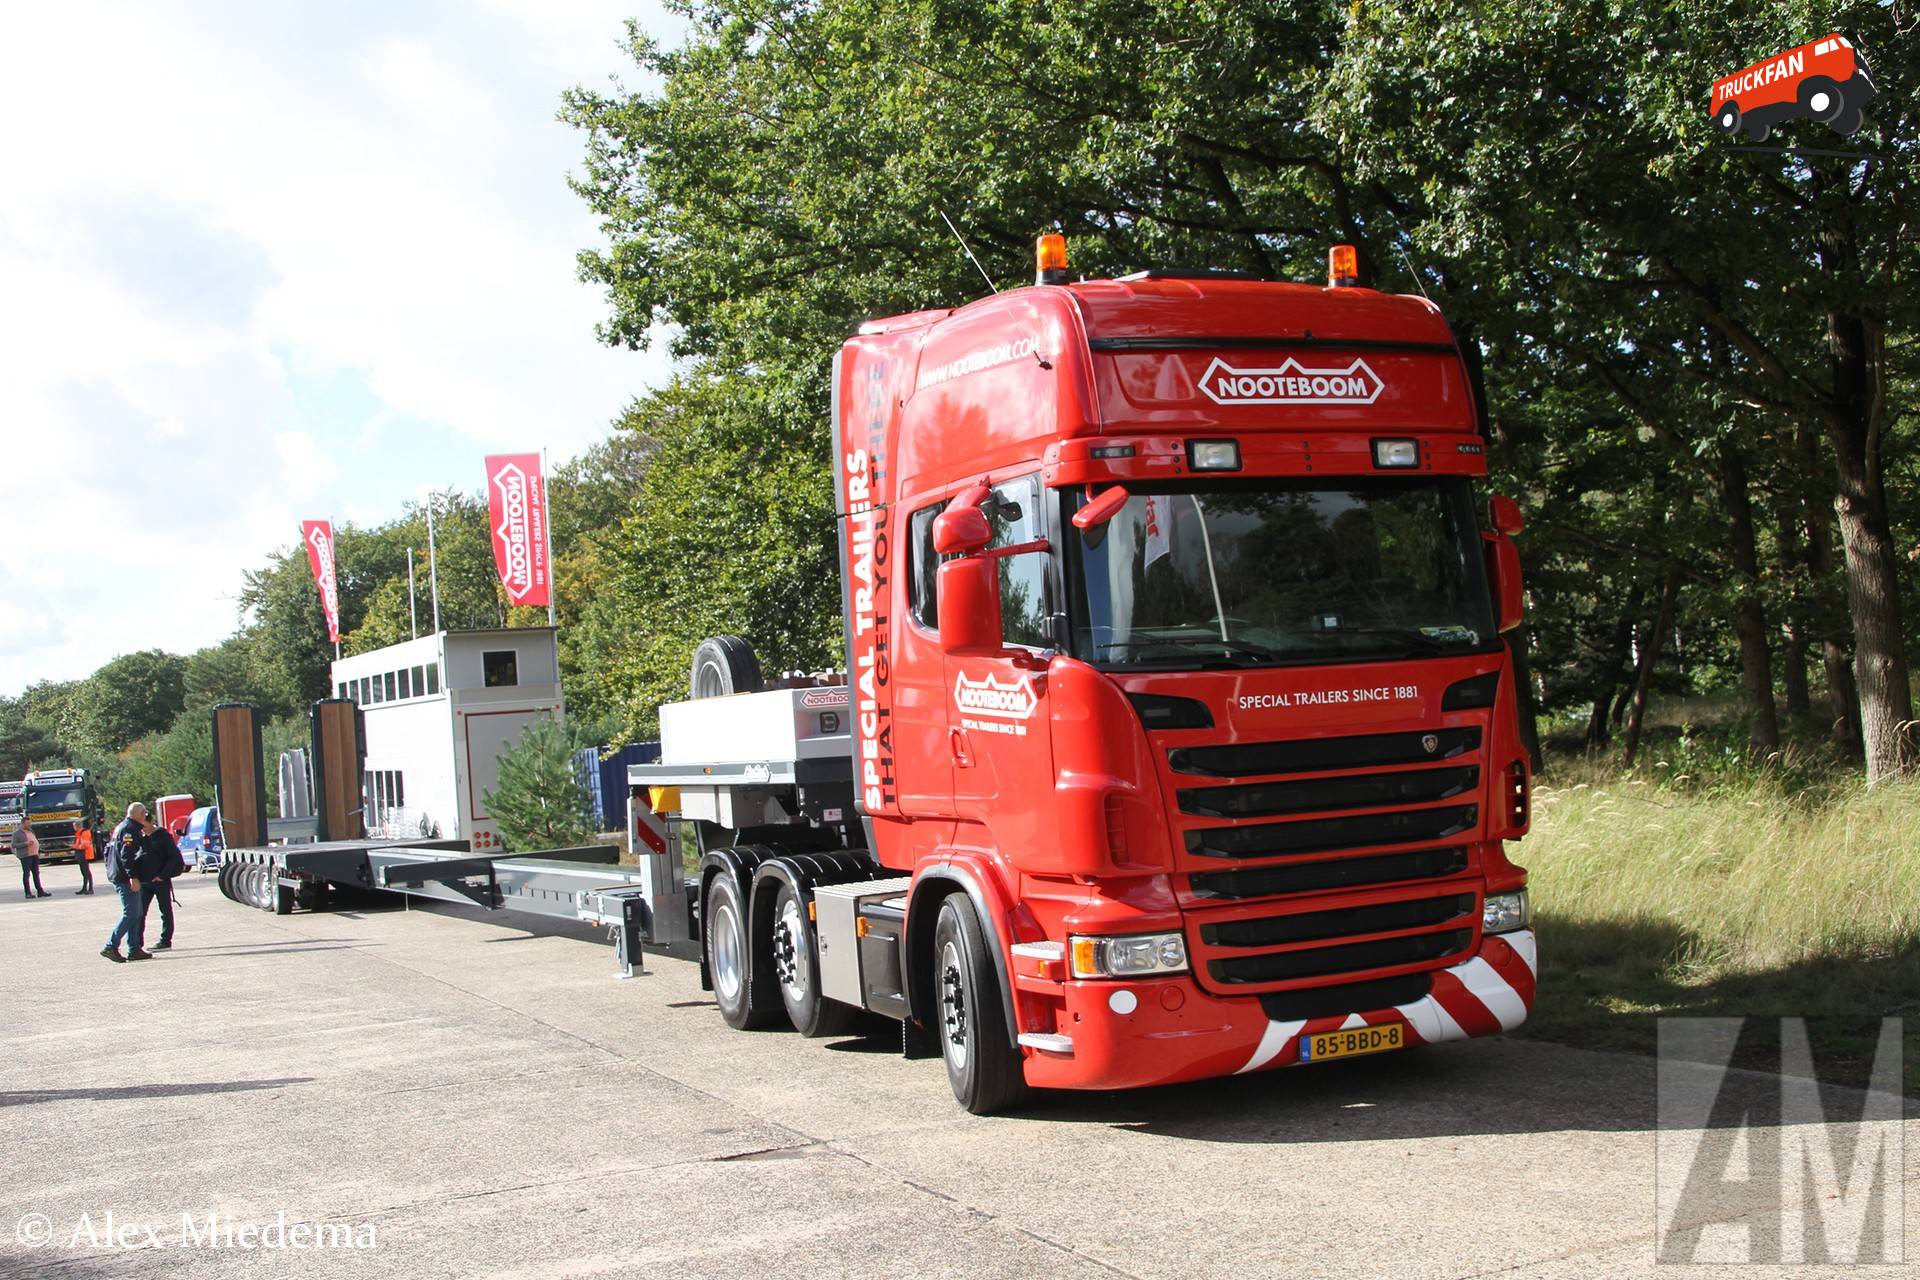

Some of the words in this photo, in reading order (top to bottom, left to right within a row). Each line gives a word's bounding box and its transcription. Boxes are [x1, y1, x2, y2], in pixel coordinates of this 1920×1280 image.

[1218, 377, 1368, 398] NOOTEBOOM
[847, 448, 873, 636] TRAILERS
[874, 502, 888, 596] YOU
[876, 610, 889, 687] GET
[807, 696, 849, 704] NOOTEBOO
[961, 688, 1027, 712] NOOTEBOOM
[1239, 694, 1291, 709] SPECIAL
[1294, 690, 1349, 705] TRAILERS
[1352, 687, 1390, 702] SINCE
[1393, 686, 1418, 699] 1881
[858, 646, 881, 811] SPECIAL
[878, 703, 895, 809] THAT
[1316, 1028, 1399, 1055] 85-BBD-8
